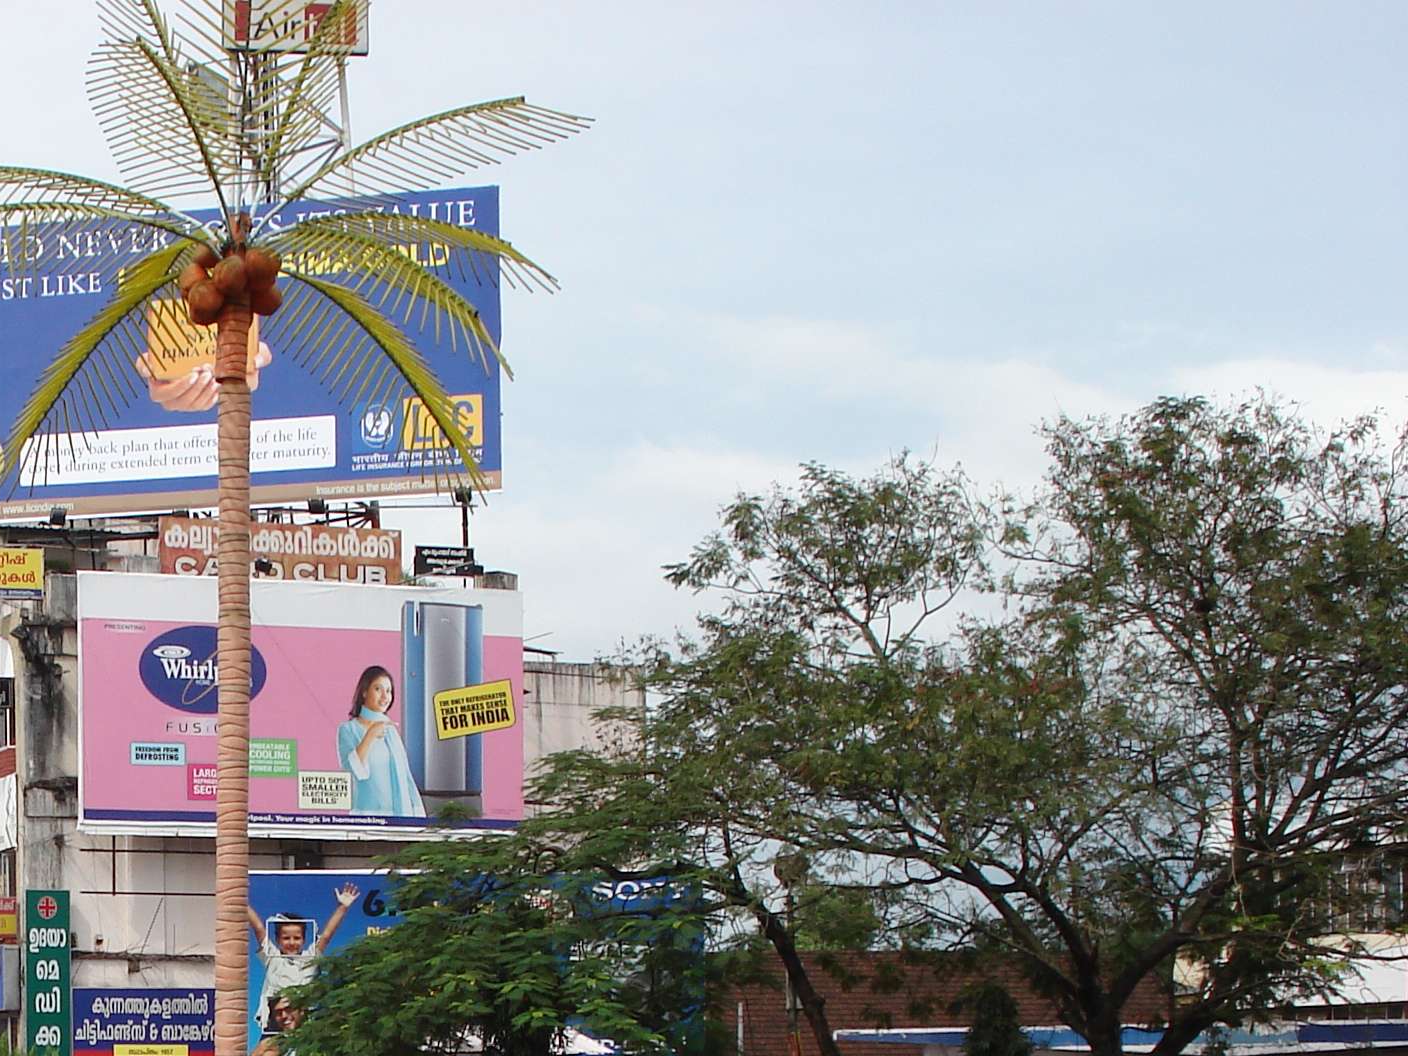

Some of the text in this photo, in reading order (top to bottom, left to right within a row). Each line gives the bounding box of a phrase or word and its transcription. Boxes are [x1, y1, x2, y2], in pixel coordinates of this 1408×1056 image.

[254, 11, 346, 42] Airtl
[42, 272, 103, 298] LIKE
[411, 400, 474, 445] LC
[122, 439, 149, 457] plan
[154, 437, 180, 451] that
[183, 434, 217, 450] offers
[256, 430, 272, 443] of
[273, 429, 293, 443] the
[298, 427, 317, 441] life
[65, 458, 106, 476] during
[110, 454, 168, 471] extended
[171, 454, 202, 467] term
[272, 444, 331, 461] maturity.
[316, 484, 355, 496] Insurance
[366, 481, 379, 492] the
[381, 479, 410, 493] subject
[174, 555, 388, 585] CAD CLUB
[440, 699, 508, 716] THAT MAKES SENSE
[441, 708, 510, 731] FOR INDIA
[135, 753, 179, 761] DEFROSTING
[249, 751, 290, 760] COOLING
[193, 785, 217, 795] SECT
[295, 815, 320, 824] magic
[332, 816, 388, 826] homemaking.
[29, 927, 67, 953] ഉദയാ
[92, 993, 208, 1019] കുന്നത്തുകളത്തിൽ
[150, 1023, 159, 1041] &
